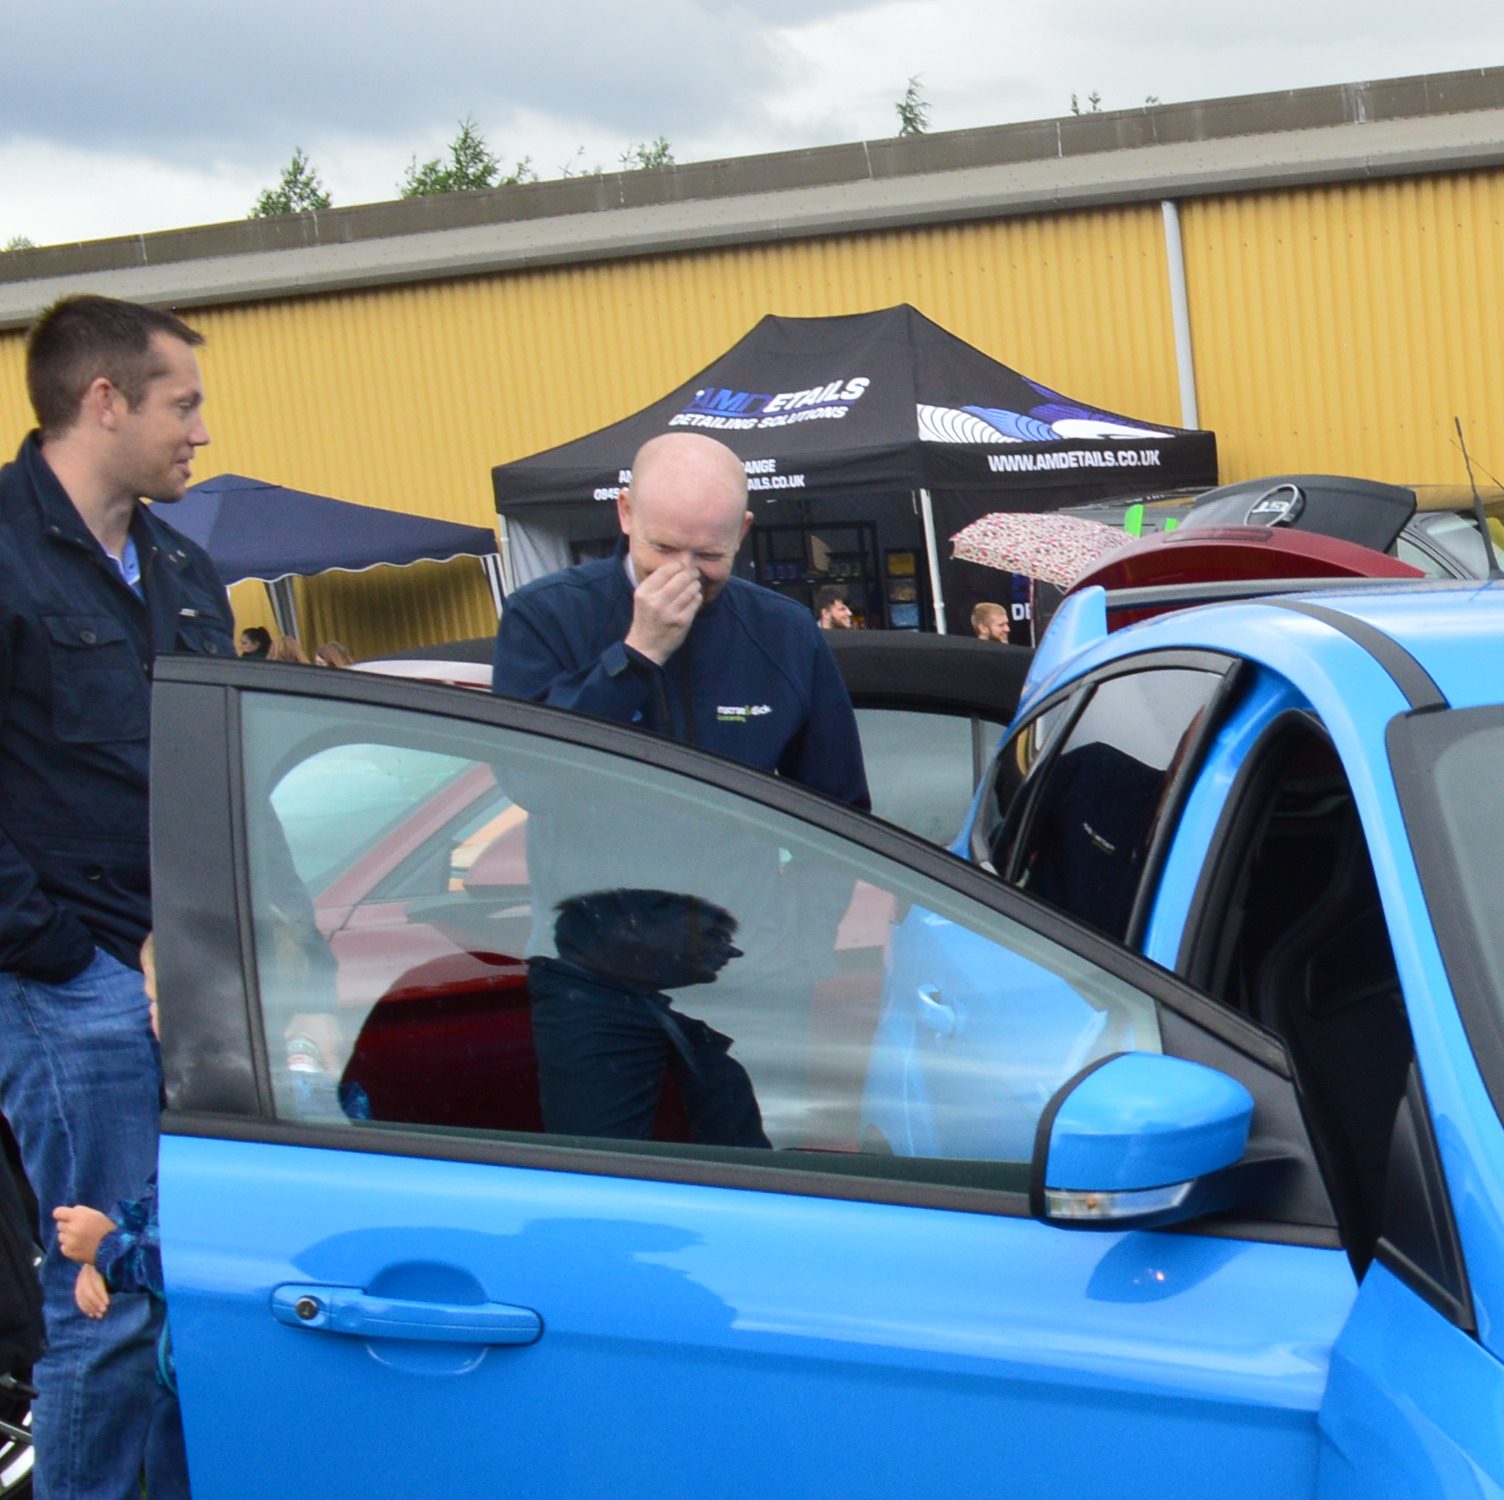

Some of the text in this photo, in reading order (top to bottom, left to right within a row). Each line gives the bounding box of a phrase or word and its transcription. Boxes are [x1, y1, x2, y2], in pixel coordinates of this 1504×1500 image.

[684, 377, 870, 413] AMDETAILS
[668, 406, 849, 429] DETAILING SOLUTIONS
[742, 459, 776, 474] ANGE
[987, 450, 1160, 472] WWW.AMDETAILS.CO.UK
